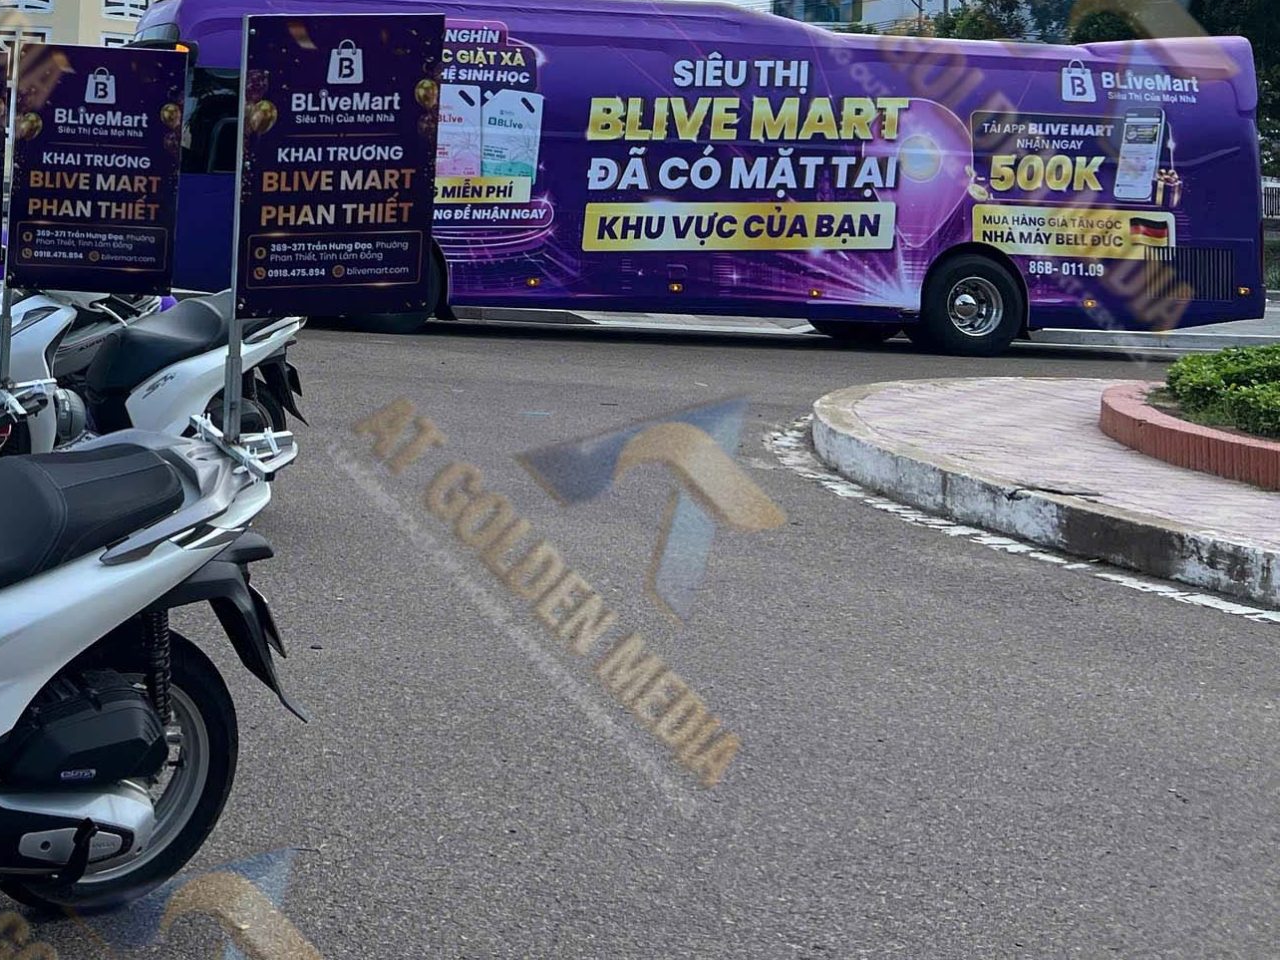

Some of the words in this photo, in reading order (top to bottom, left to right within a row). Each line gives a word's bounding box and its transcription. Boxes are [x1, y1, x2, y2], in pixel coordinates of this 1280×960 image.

[457, 47, 497, 67] GIẶT
[501, 48, 525, 66] XÀ
[459, 69, 494, 81] SINH
[496, 70, 529, 85] HỌC
[673, 52, 747, 87] SIÊU
[755, 60, 809, 94] THỊ
[1101, 70, 1199, 92] BLiveMart
[291, 89, 400, 112] BLiveMart
[55, 106, 148, 128] BLiveMart
[296, 114, 316, 124] Siêu
[320, 114, 333, 125] Thị
[336, 113, 354, 123] Của
[357, 114, 373, 124] Mọi
[376, 113, 395, 122] Nhà
[587, 96, 740, 143] BLIVE
[750, 96, 910, 143] MART
[983, 121, 1002, 133] TẢI
[1003, 124, 1025, 134] APP
[1028, 123, 1069, 135] BLIVE
[1071, 124, 1114, 137] MART
[277, 147, 322, 162] KHAI
[327, 144, 404, 162] TRƯƠNG
[1017, 136, 1049, 152] NHẬN
[1052, 140, 1084, 150] NGAY
[42, 152, 80, 166] KHAI
[84, 153, 151, 169] TRƯƠNG
[262, 170, 334, 192] BLIVE
[340, 168, 416, 190] MART
[588, 146, 649, 190] ĐÃ
[658, 144, 721, 190] CÓ
[729, 147, 823, 198] MẶT
[831, 156, 897, 197] TẠI
[990, 154, 1106, 192] 500K
[30, 170, 90, 190] BLIVE
[96, 174, 161, 193] MART
[442, 179, 482, 198] MIỄN
[486, 181, 513, 198] PHÍ
[28, 199, 91, 217] PHAN
[98, 195, 160, 220] THIẾT
[260, 204, 335, 226] PHAN
[342, 192, 414, 223] THIẾT
[454, 204, 471, 219] ĐỂ
[472, 206, 509, 222] NHẬN
[511, 209, 547, 219] NGAY
[597, 215, 665, 240] KHU
[673, 211, 737, 246] VỰC
[744, 206, 808, 238] CỦA
[815, 214, 881, 245] BẠN
[983, 215, 1009, 225] MUA
[1012, 214, 1045, 226] HÀNG
[983, 227, 1017, 243] NHÀ
[1020, 228, 1051, 245] MÁY
[1056, 235, 1088, 246] BELL
[1091, 231, 1123, 247] ĐỨC
[267, 268, 325, 278] 0918.475.894
[347, 266, 409, 275] blivemart.com
[1029, 261, 1058, 274] 86B-
[1062, 263, 1104, 276] 011.09
